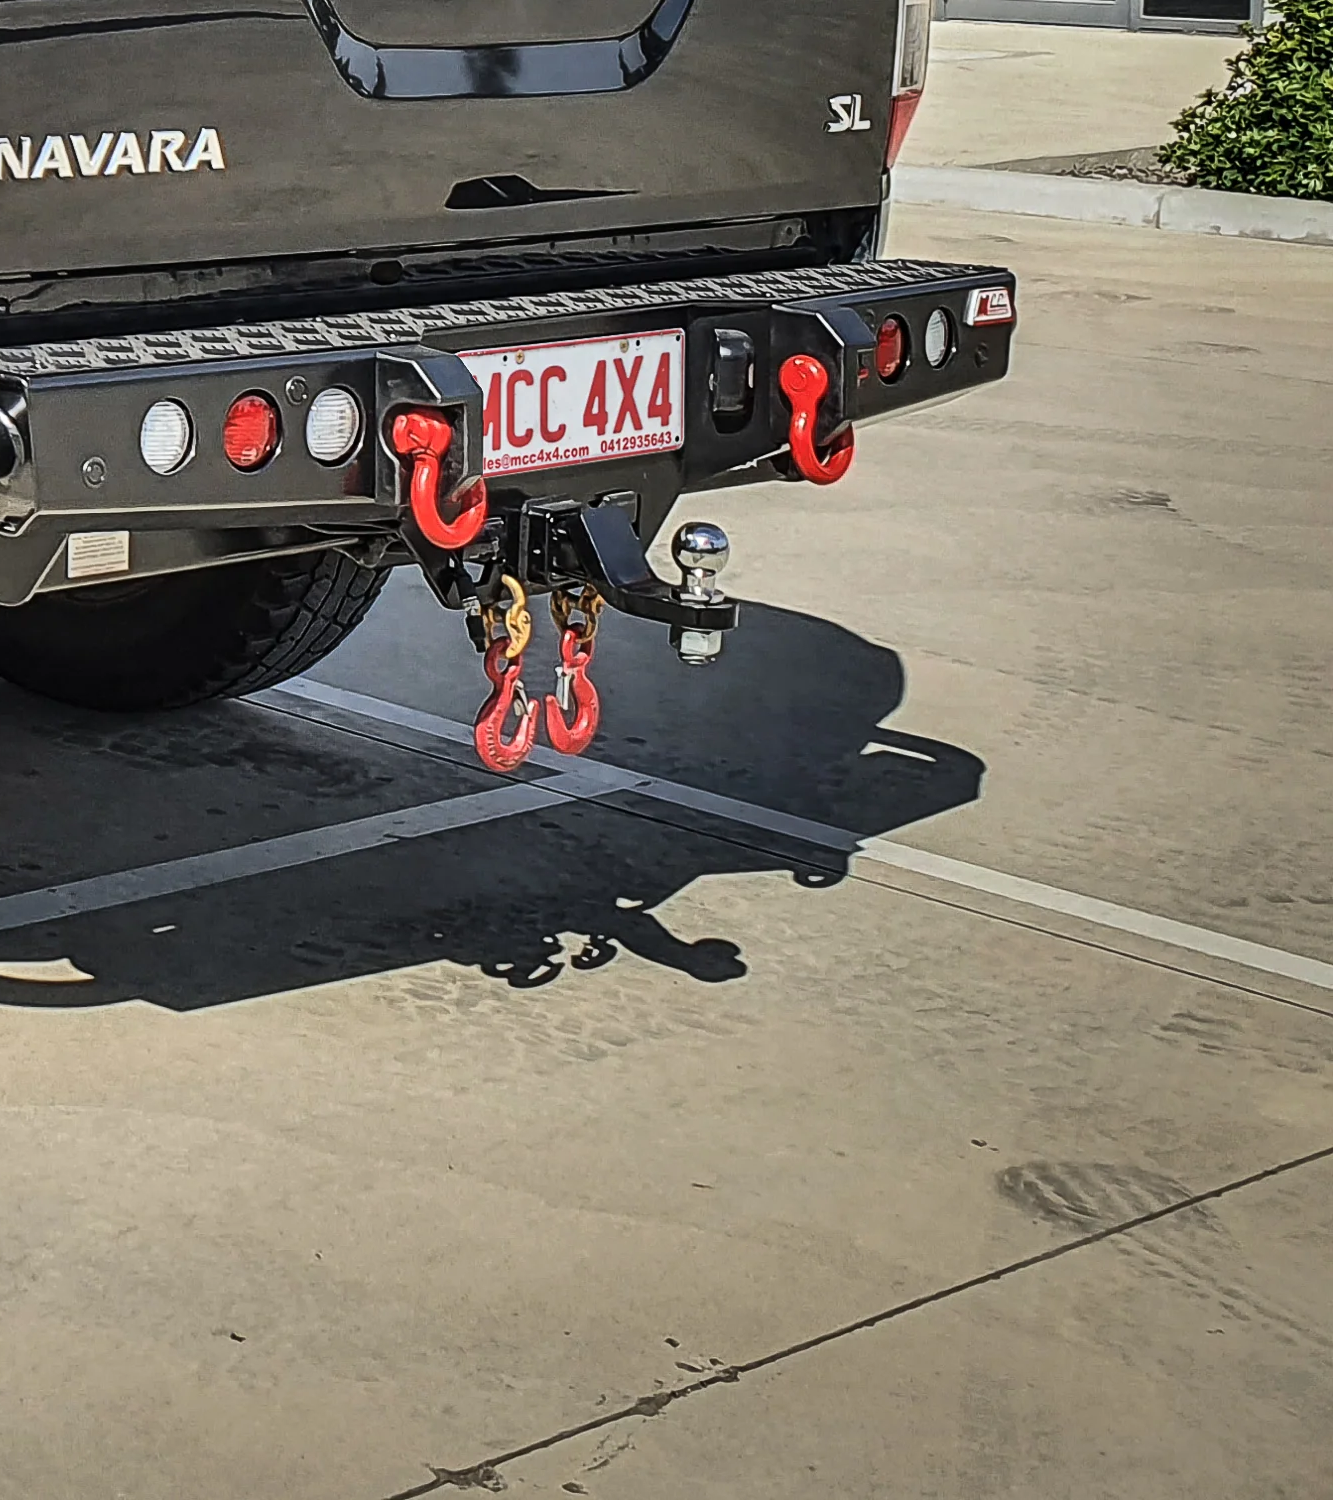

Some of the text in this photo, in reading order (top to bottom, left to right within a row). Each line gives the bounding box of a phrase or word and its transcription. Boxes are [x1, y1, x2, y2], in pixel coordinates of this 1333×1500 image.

[824, 93, 871, 132] SL
[583, 352, 672, 436] 4X4
[600, 431, 673, 454] 0412935643
